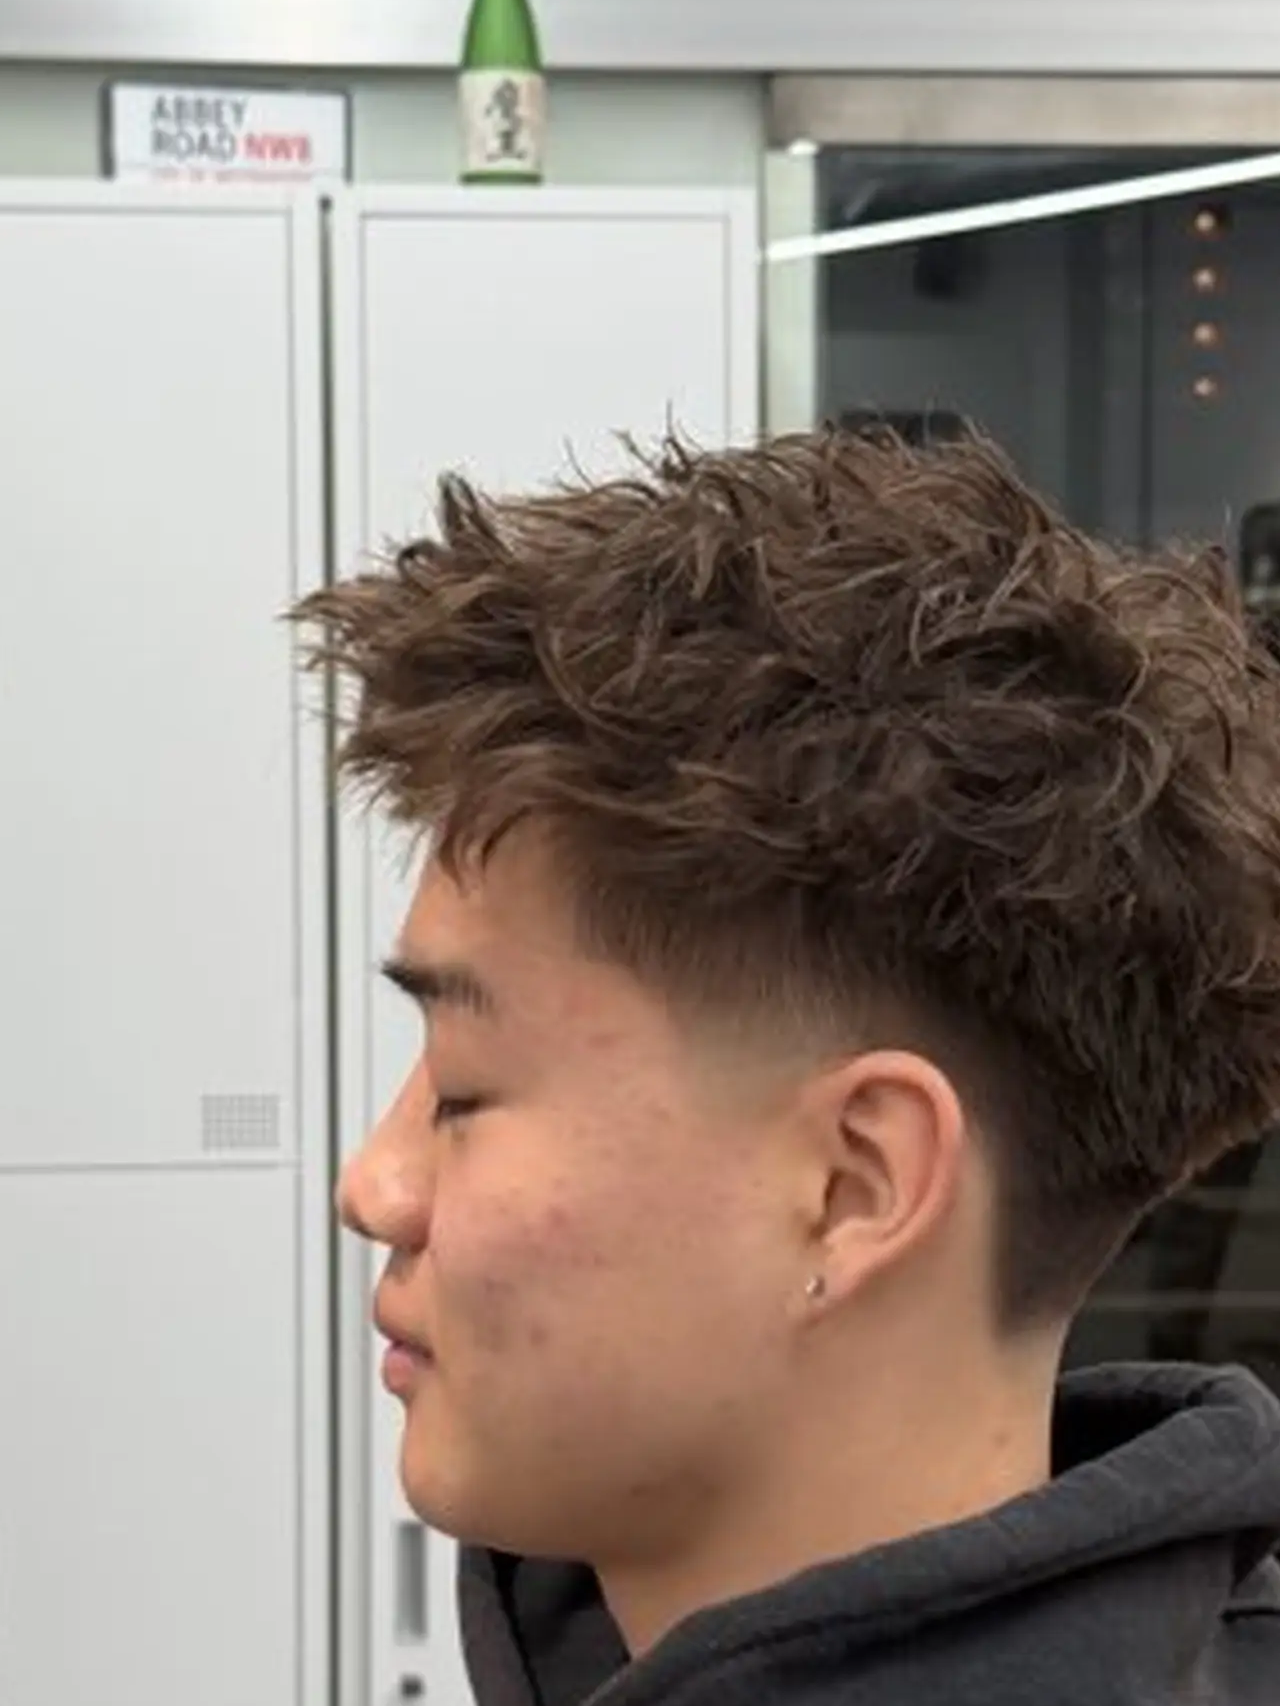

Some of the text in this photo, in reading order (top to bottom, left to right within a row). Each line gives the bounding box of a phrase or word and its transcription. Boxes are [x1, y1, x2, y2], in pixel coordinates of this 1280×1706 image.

[152, 96, 246, 125] ABBEY
[151, 129, 312, 162] ROAD NW8
